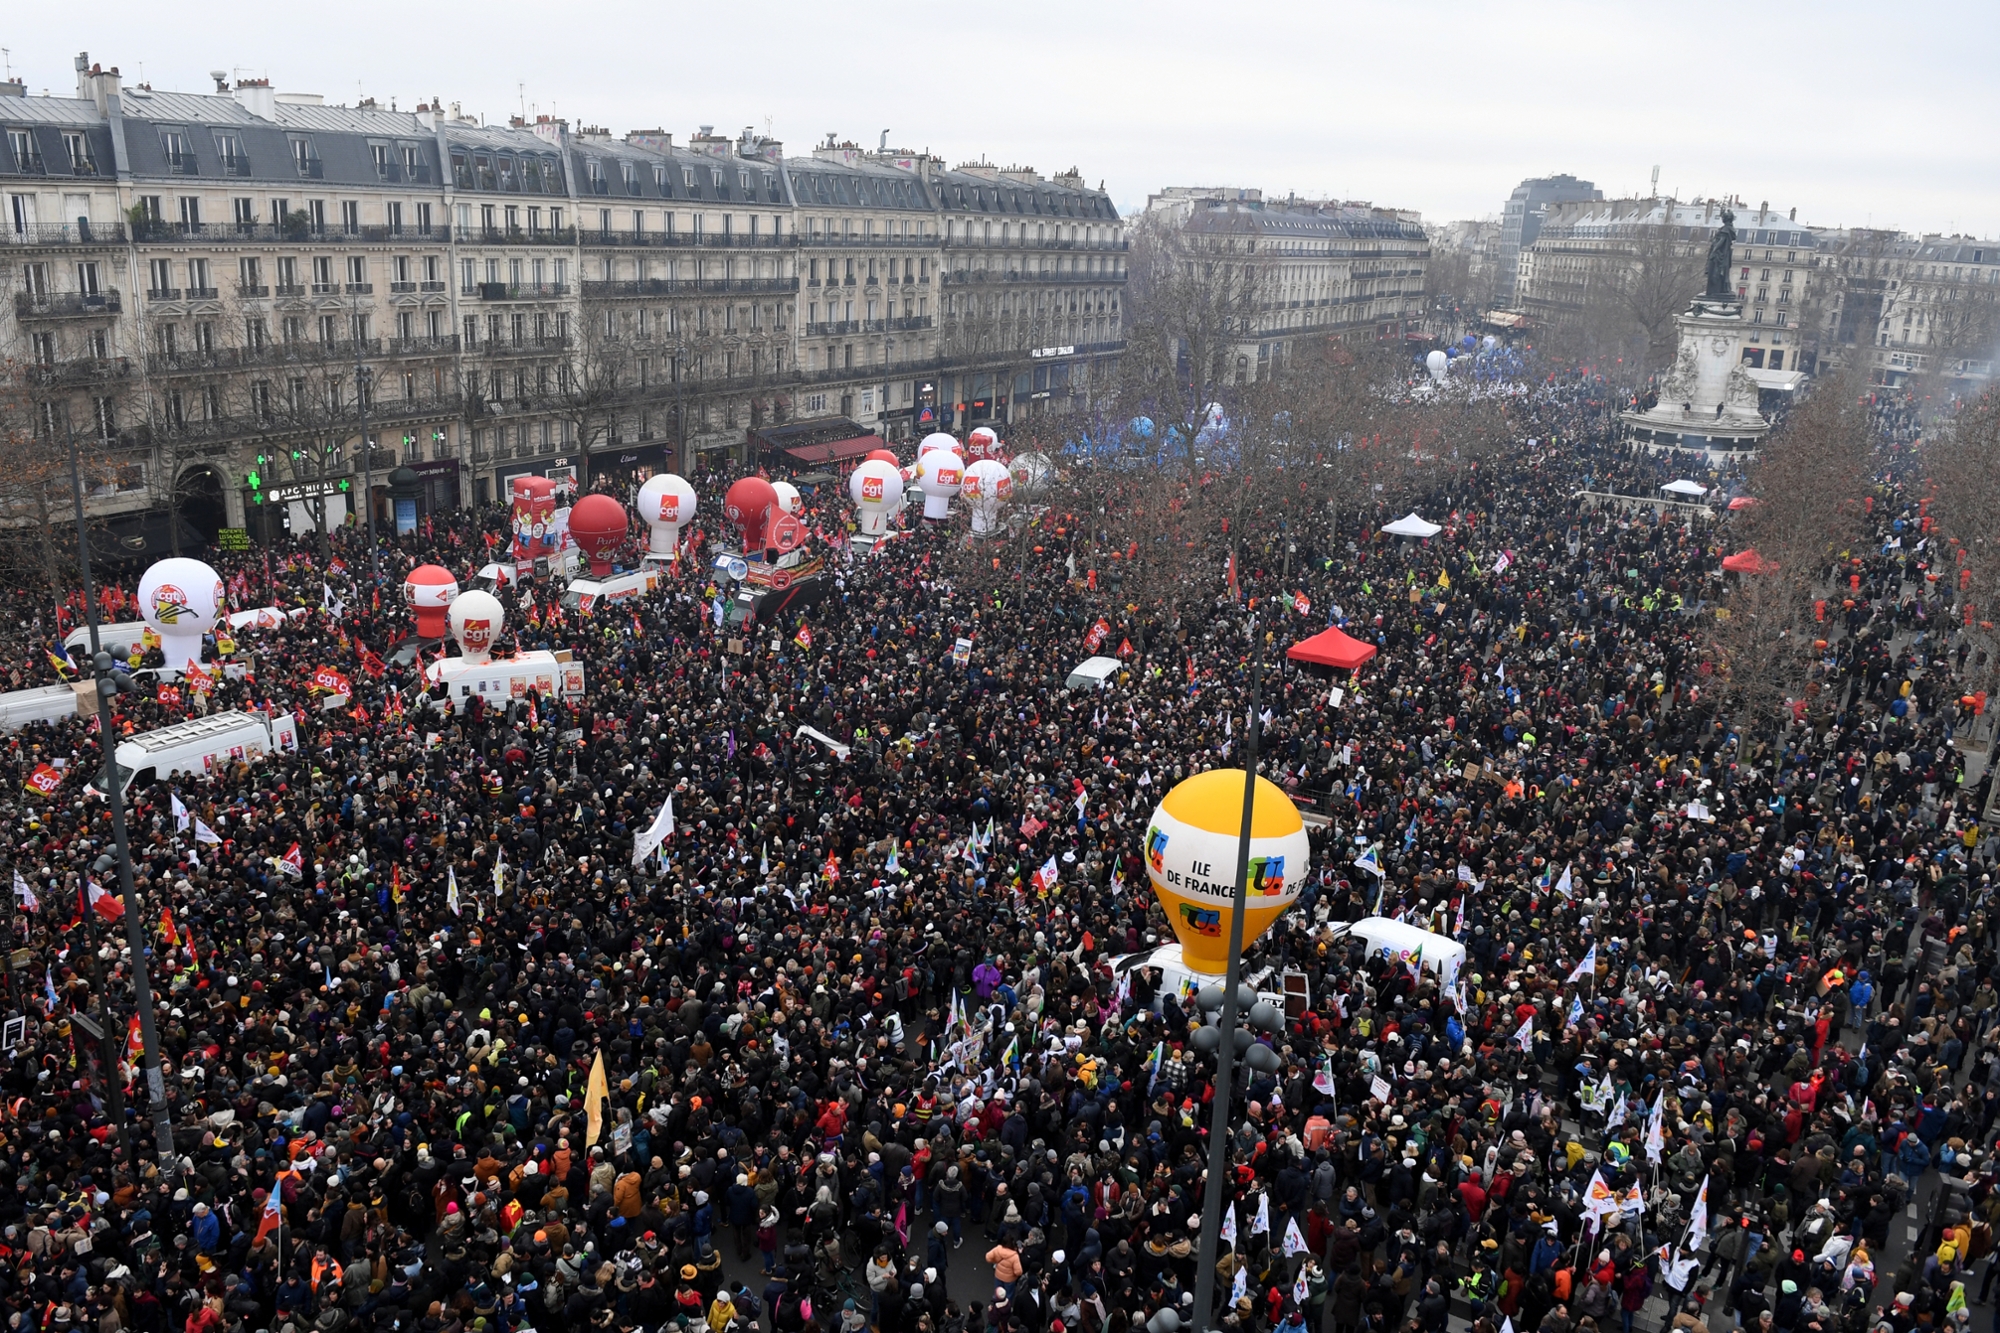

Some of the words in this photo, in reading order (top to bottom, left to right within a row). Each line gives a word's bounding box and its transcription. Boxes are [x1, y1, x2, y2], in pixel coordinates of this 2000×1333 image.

[969, 444, 985, 456] cgt
[555, 458, 568, 468] SFR
[620, 455, 638, 464] Etam
[940, 474, 955, 484] cgt
[863, 485, 882, 497] cgt
[660, 506, 679, 518] cgt
[596, 536, 619, 545] Paris
[596, 549, 616, 560] cgt
[329, 562, 343, 575] cgt
[160, 592, 179, 605] cgt
[1295, 598, 1310, 615] cgt
[464, 628, 491, 642] cgt
[192, 677, 213, 690] cgt
[317, 673, 338, 687] cgt
[33, 773, 60, 792] cgt
[1191, 860, 1211, 877] ILE
[1167, 869, 1181, 886] DE
[1185, 877, 1236, 898] FRANCE
